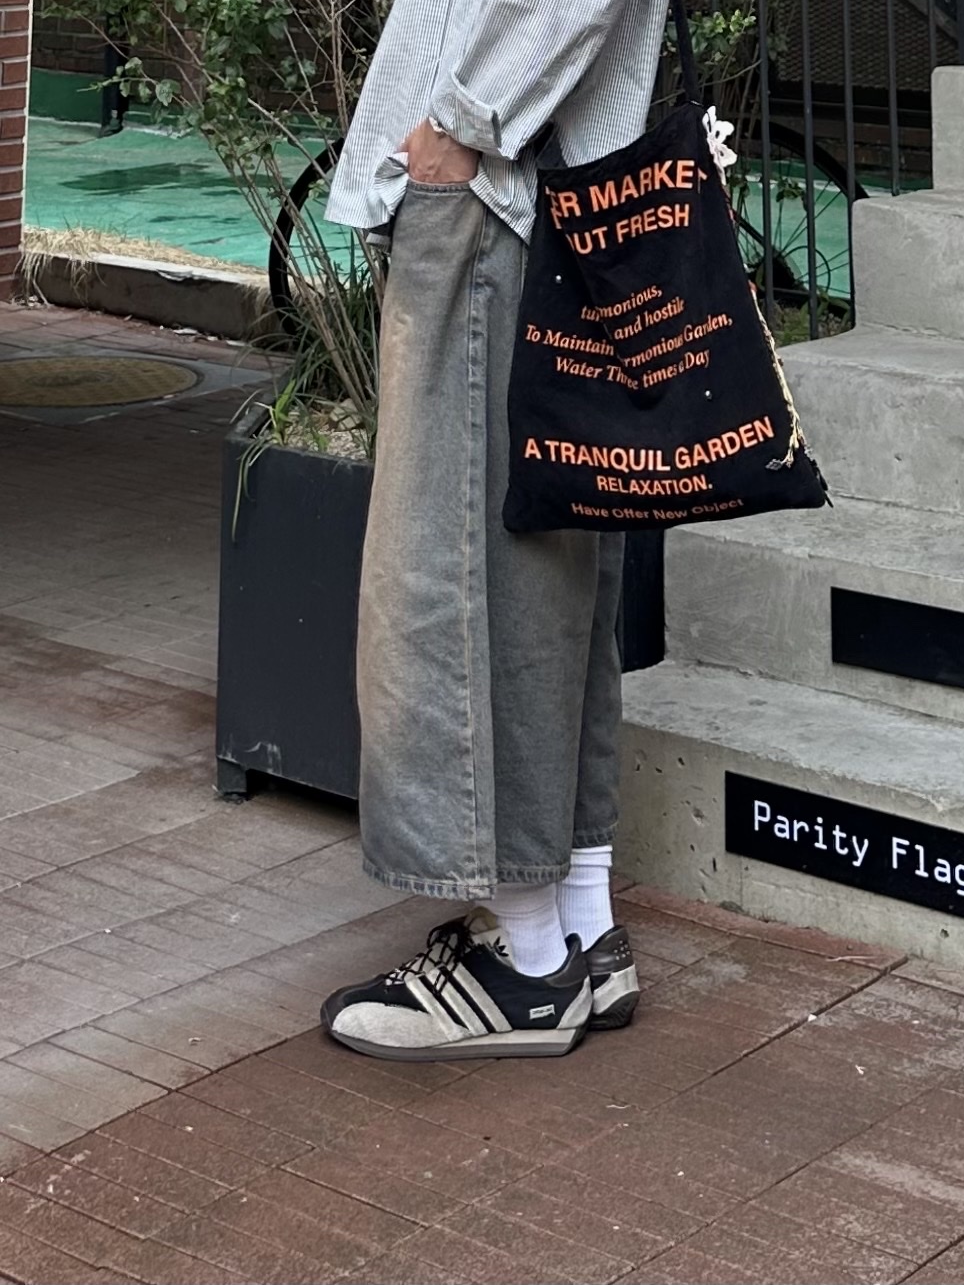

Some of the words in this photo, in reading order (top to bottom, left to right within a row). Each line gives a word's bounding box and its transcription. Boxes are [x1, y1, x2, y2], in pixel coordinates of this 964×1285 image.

[566, 226, 608, 255] UT
[616, 203, 690, 244] FRESH
[525, 323, 541, 342] To
[543, 329, 615, 356] Maintain
[683, 314, 734, 343] Garden,
[613, 314, 641, 341] and
[555, 356, 604, 379] Water
[684, 348, 711, 370] Day
[524, 437, 542, 460] A
[544, 439, 672, 475] TRANQUIL
[674, 416, 776, 471] GARDEN
[596, 474, 714, 496] RELAXATION.
[570, 502, 608, 518] Have
[611, 508, 649, 519] Offer
[652, 509, 688, 520] New
[691, 498, 744, 514] Object
[753, 800, 869, 867] Parity
